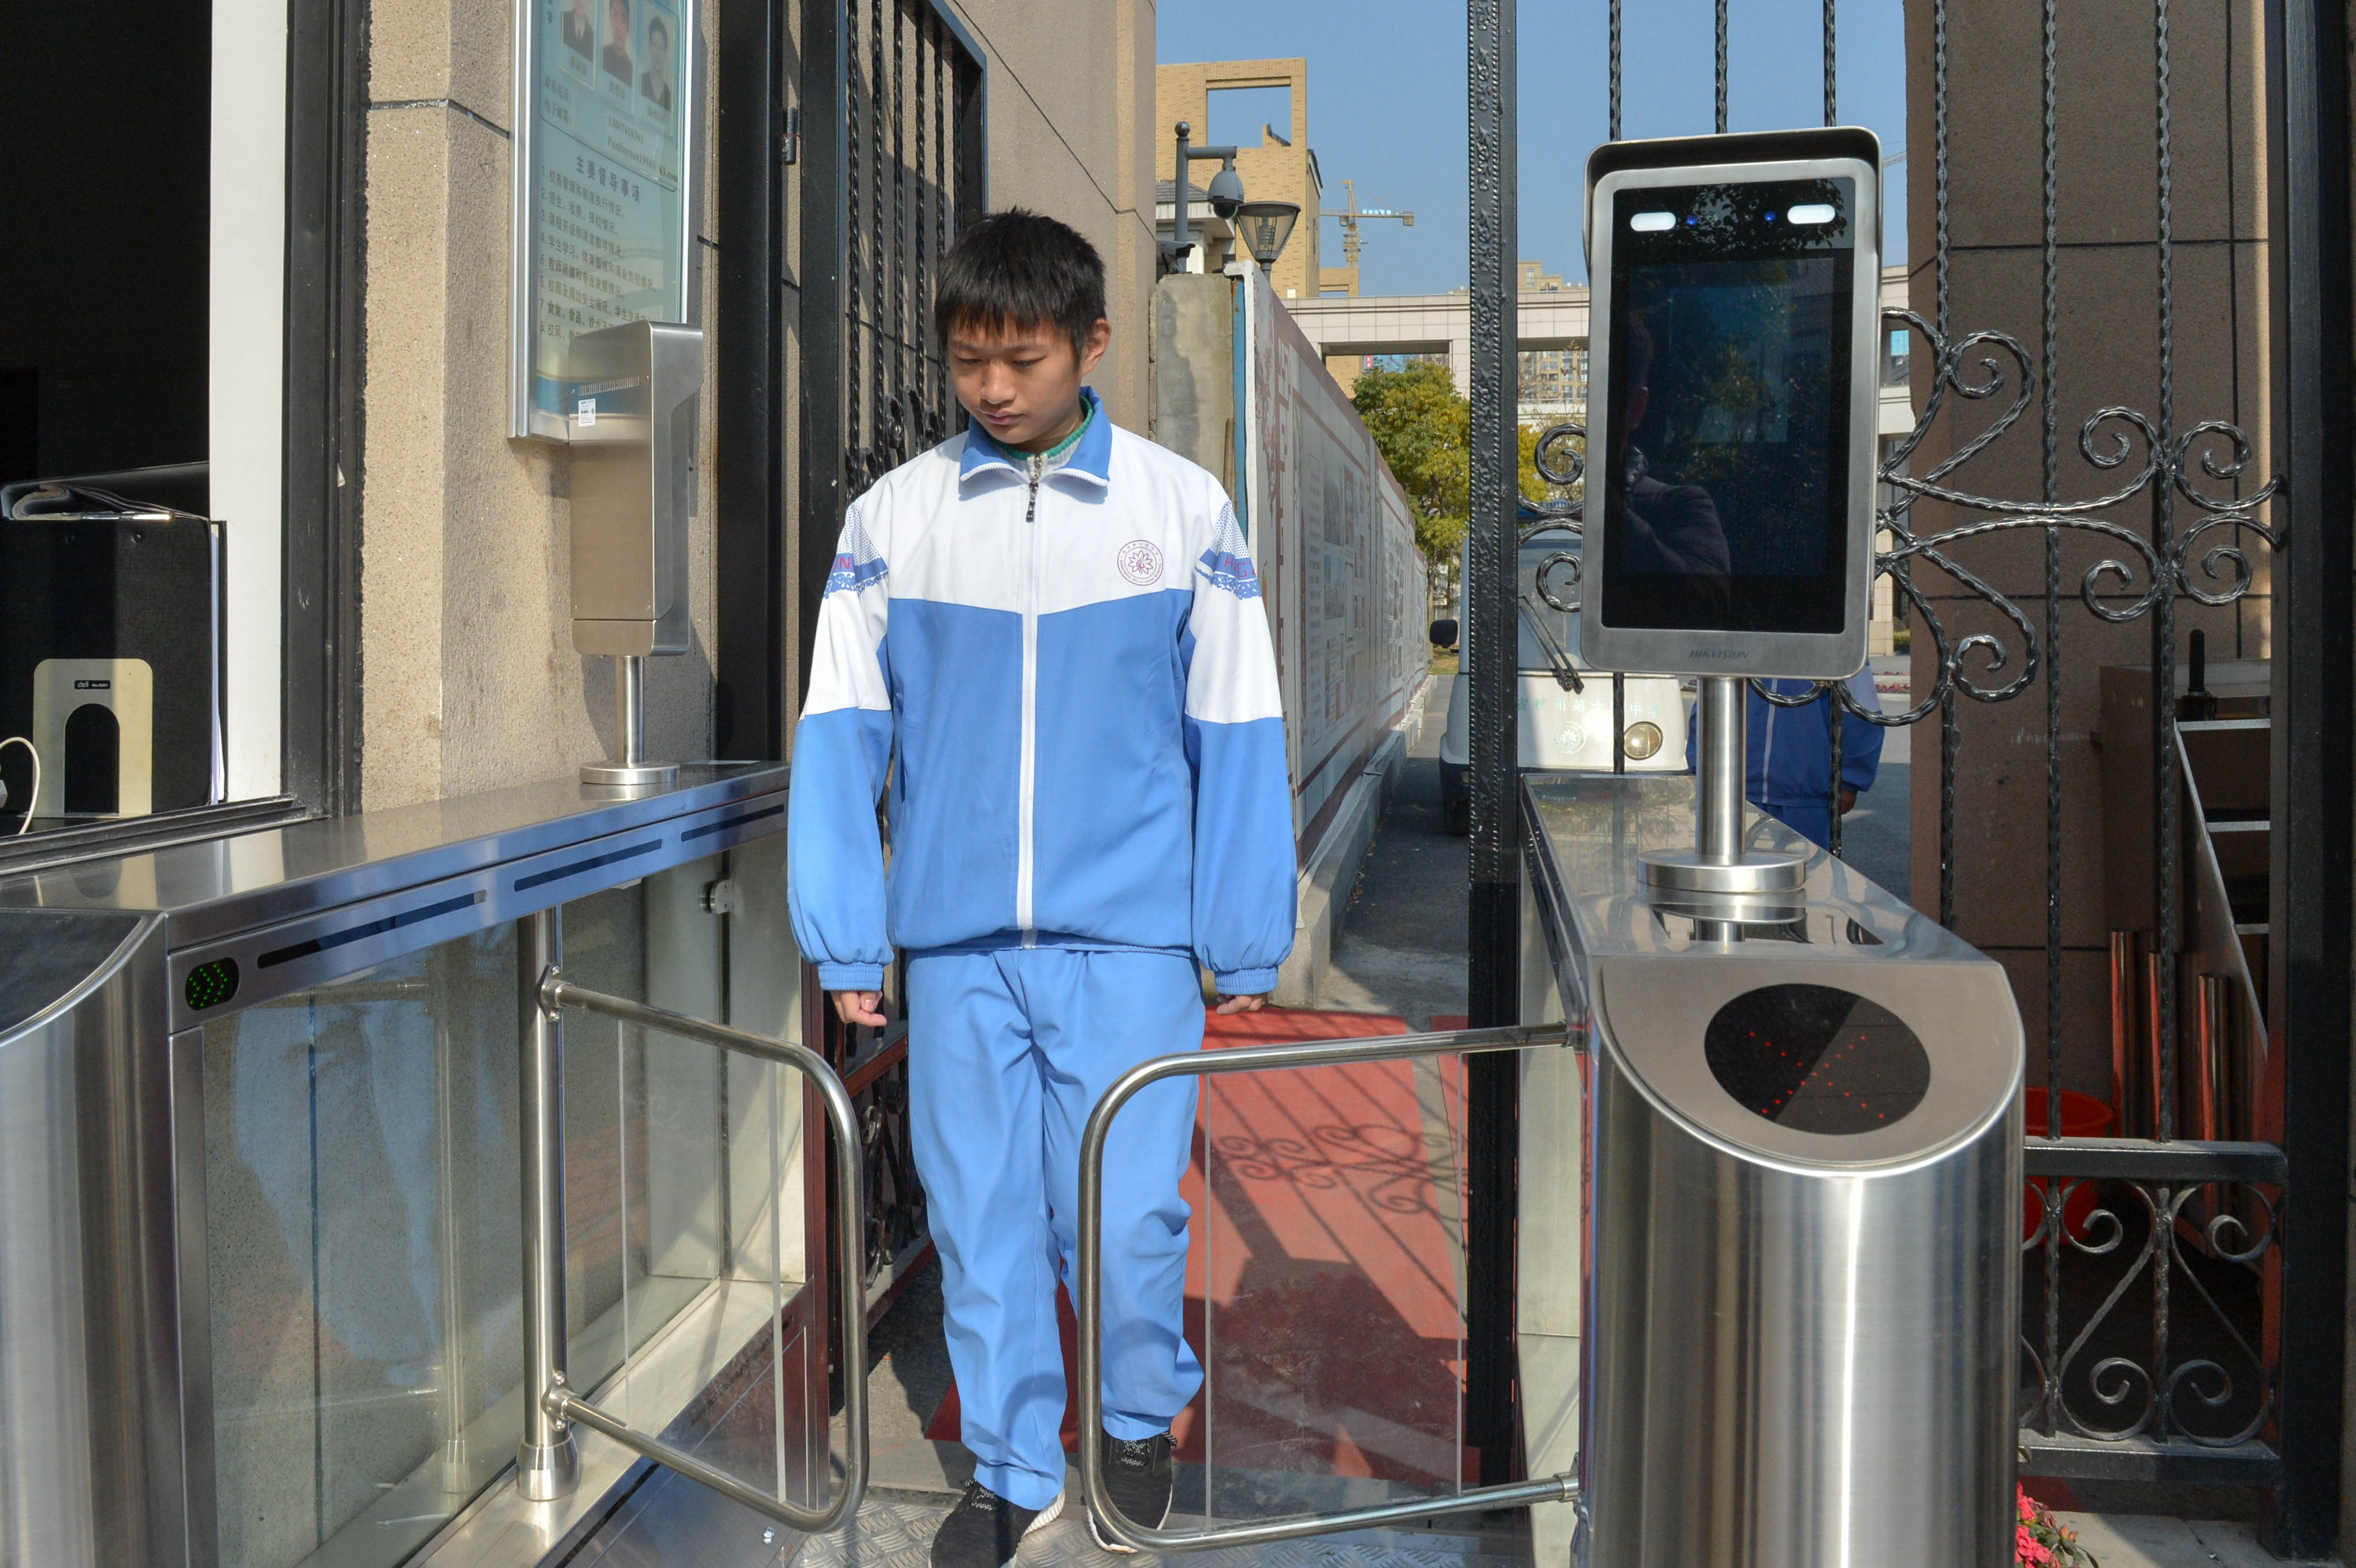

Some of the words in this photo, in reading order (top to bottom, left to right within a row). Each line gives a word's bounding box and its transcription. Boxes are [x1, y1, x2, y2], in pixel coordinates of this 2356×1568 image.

[576, 155, 641, 203] 主要督导事项
[1689, 649, 1749, 660] HIKVISION
